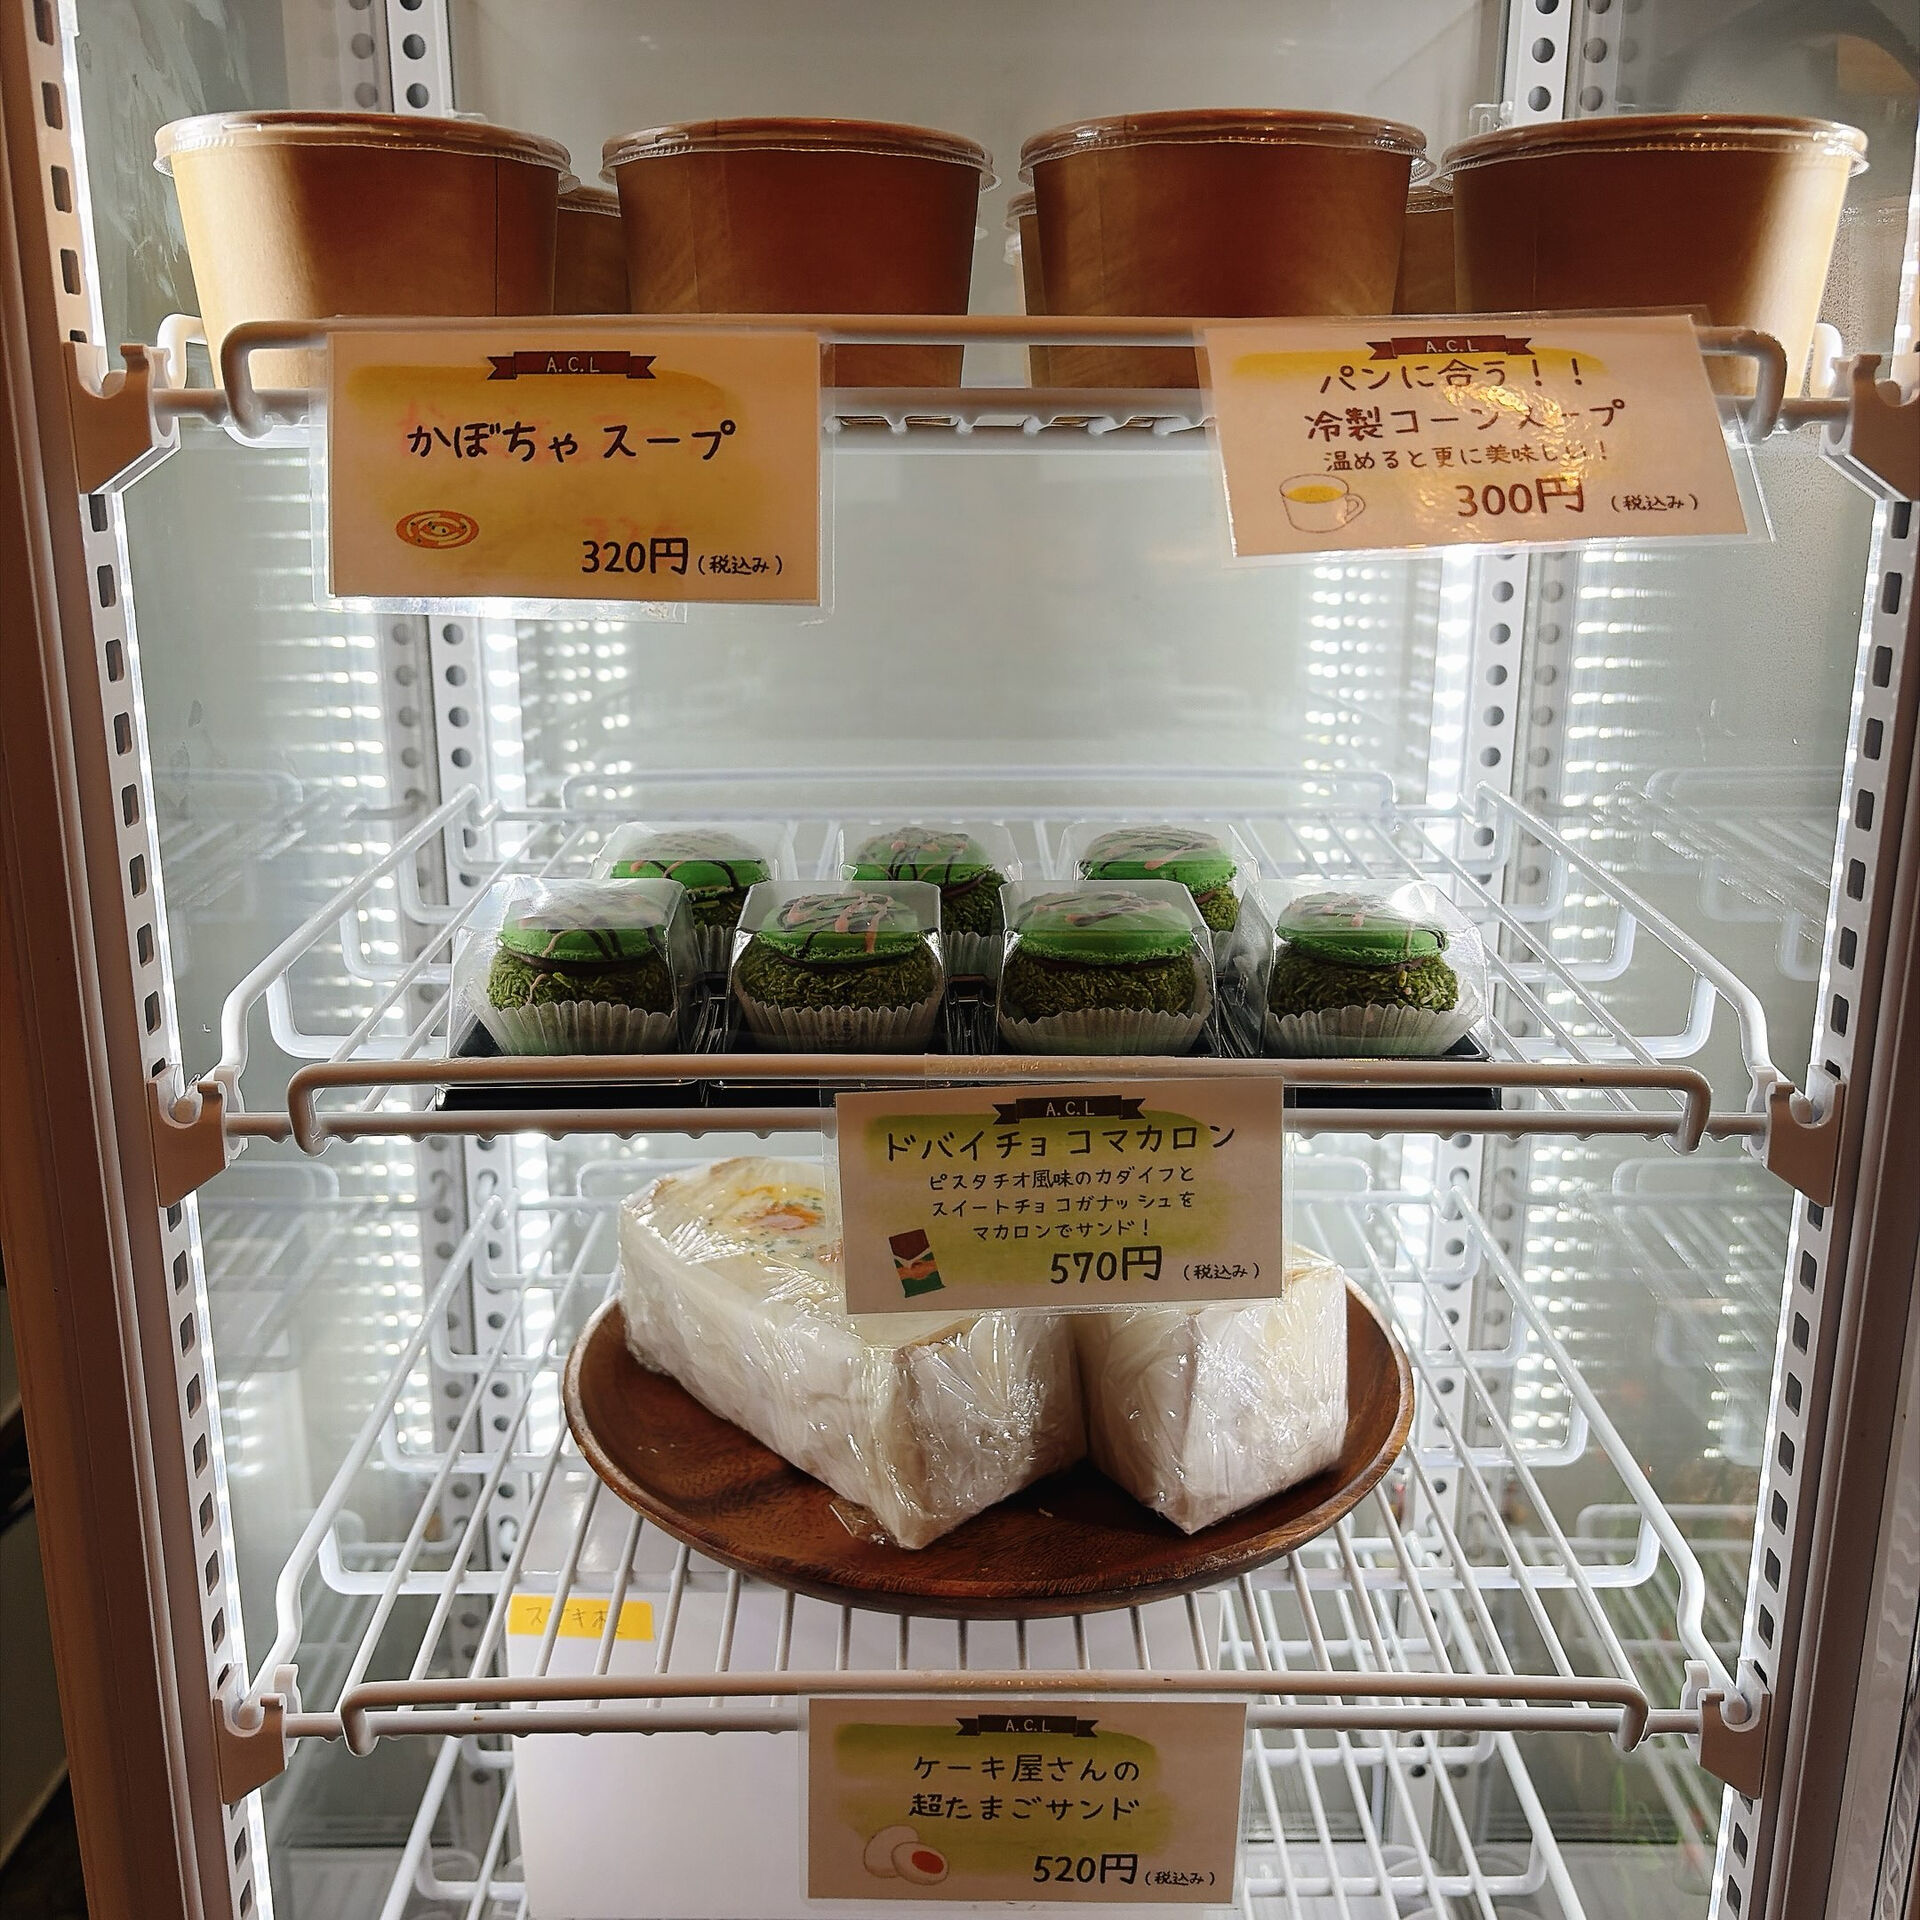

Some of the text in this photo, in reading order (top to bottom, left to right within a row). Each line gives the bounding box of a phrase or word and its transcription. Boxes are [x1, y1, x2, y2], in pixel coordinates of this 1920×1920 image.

[1426, 338, 1480, 353] A.C.L
[547, 356, 600, 373] A.C.L
[1457, 478, 1585, 518] 300円
[582, 537, 689, 576] 320円
[1046, 1101, 1095, 1118] A.C.L
[886, 1125, 1235, 1163] ドバイチョコマカロン
[929, 1165, 1195, 1191] ピスタチオ風味のカダイフと
[931, 1191, 1194, 1217] スイートチョコガナッシュを
[973, 1218, 1150, 1241] マカロンでサンド！
[1050, 1245, 1163, 1285] 570円
[1005, 1719, 1051, 1732] A.C.L
[913, 1753, 1140, 1783] ケーキ屋さんの
[908, 1793, 1140, 1821] 超たまごサンド
[1033, 1853, 1138, 1885] 520円
